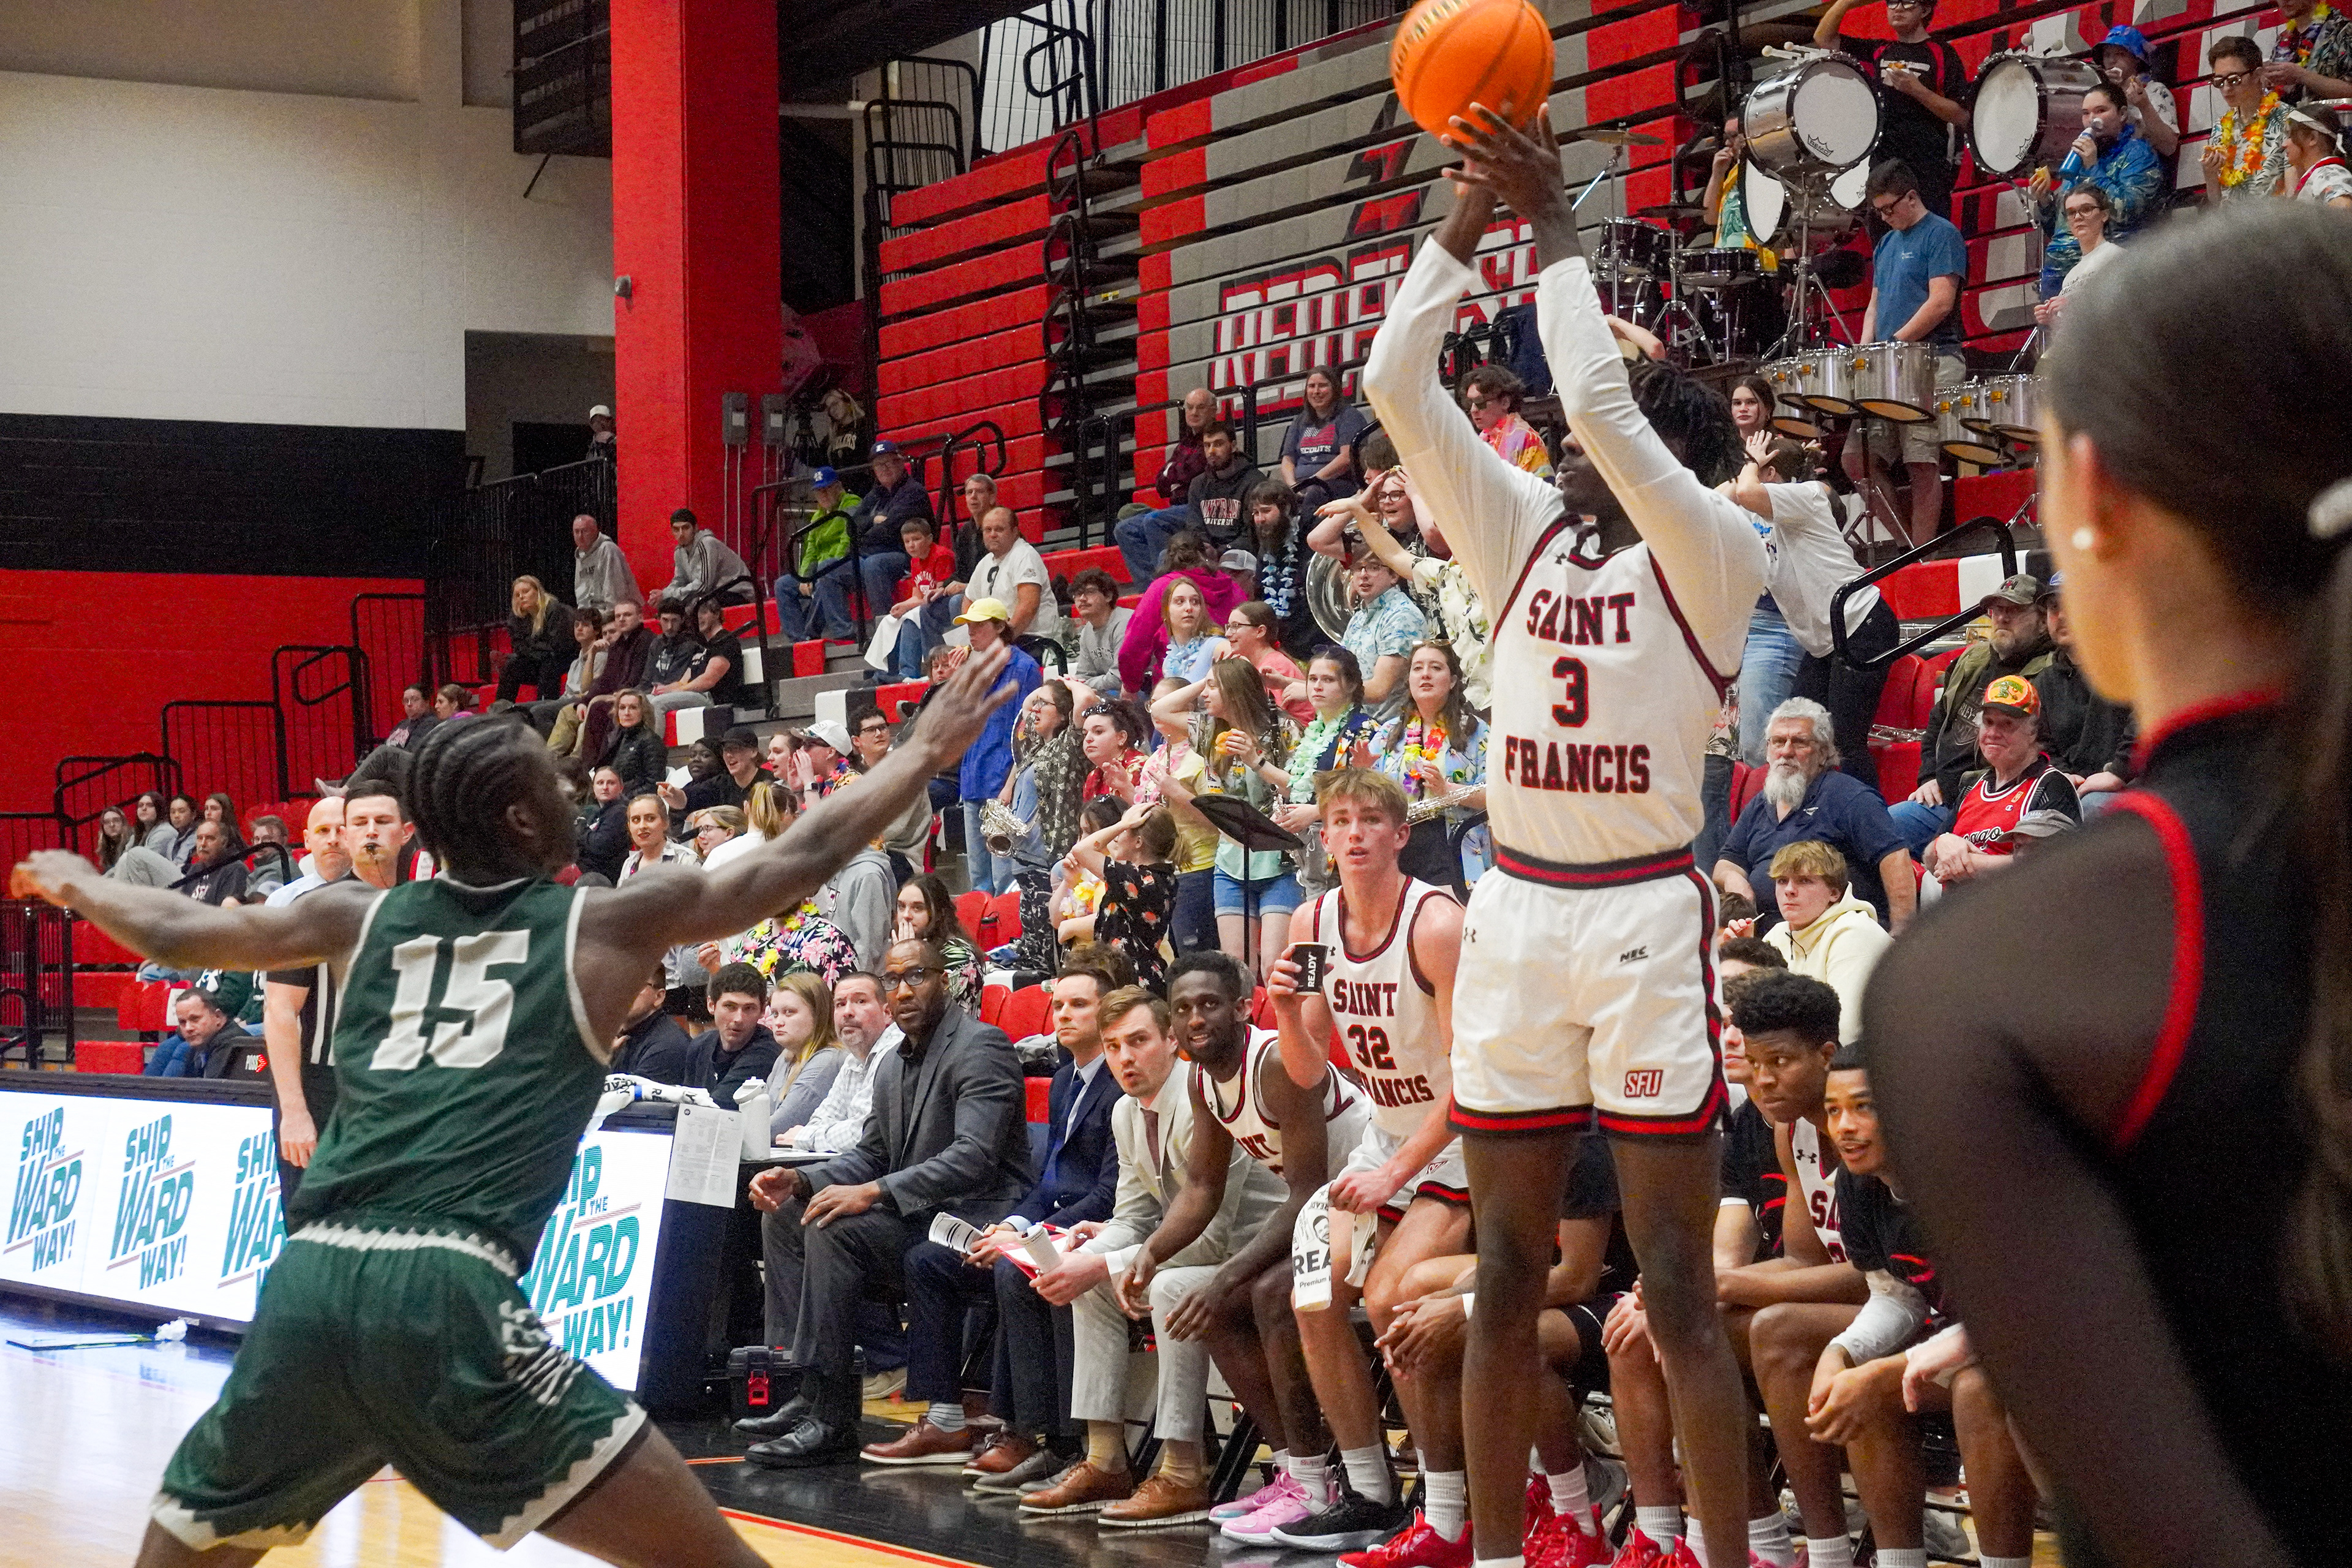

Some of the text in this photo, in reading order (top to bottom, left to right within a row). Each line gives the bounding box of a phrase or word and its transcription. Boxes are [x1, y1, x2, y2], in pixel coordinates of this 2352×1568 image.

[1300, 445, 1332, 454] SCOUTS
[1527, 588, 1635, 646] SAINT
[1552, 656, 1589, 728] 3
[1505, 734, 1651, 794] FRANCIS
[1307, 953, 1317, 987] READY
[1333, 978, 1398, 1017] SAINT
[369, 929, 531, 1071] 15
[1348, 1023, 1398, 1069] 32
[1626, 1071, 1661, 1096] SFU
[20, 1106, 64, 1161] SHIP
[124, 1114, 172, 1173] SHIP
[6, 1159, 82, 1245] WARD
[110, 1170, 194, 1261] WARD
[590, 1195, 608, 1215] THE
[32, 1219, 75, 1273] WAY!
[140, 1234, 187, 1290] WAY!
[521, 1215, 639, 1317] WARD
[1299, 1277, 1327, 1288] Premium
[564, 1295, 634, 1359] WAY!
